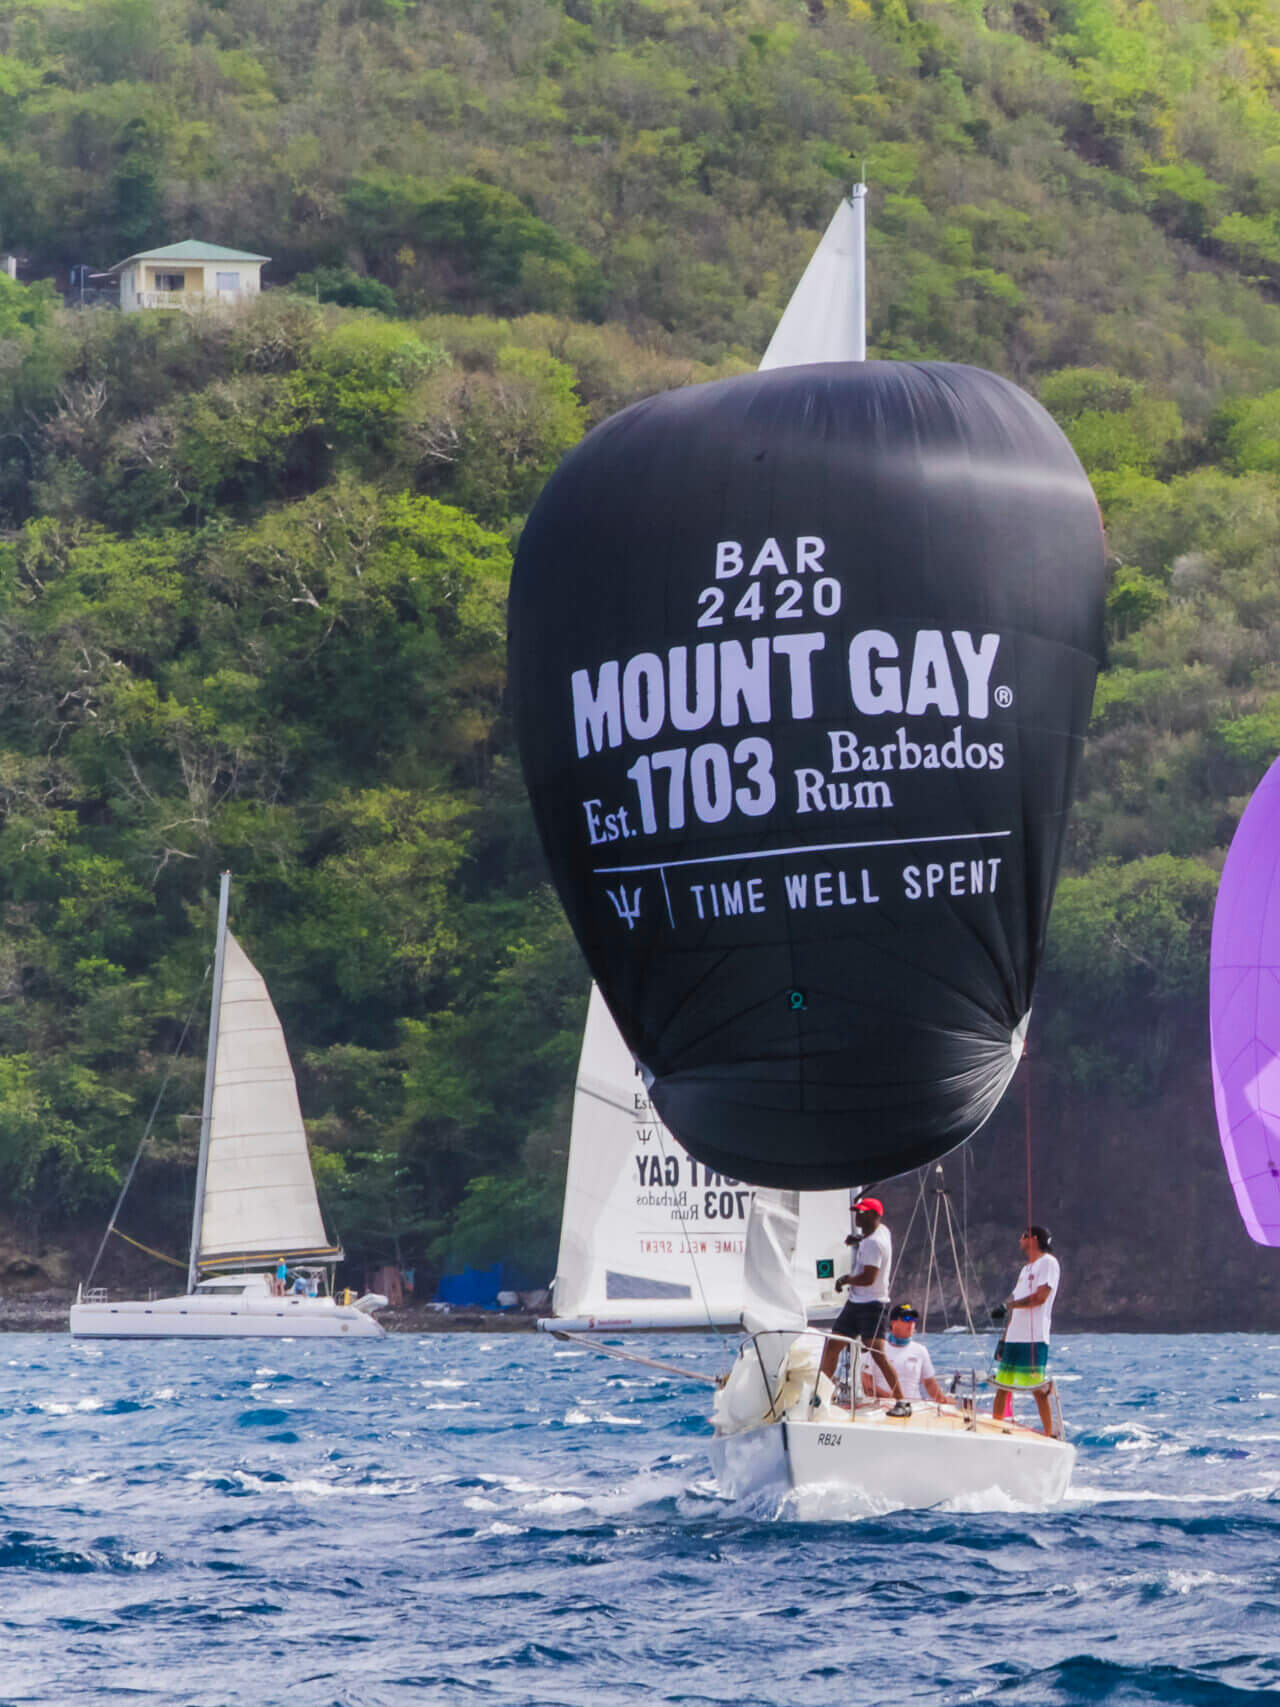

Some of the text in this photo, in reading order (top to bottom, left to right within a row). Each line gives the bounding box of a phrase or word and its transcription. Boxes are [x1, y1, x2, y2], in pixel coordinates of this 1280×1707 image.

[715, 535, 826, 580] BAR
[697, 577, 842, 628] 2420
[571, 631, 826, 758] MOUNT
[827, 725, 1005, 774] Barbados
[583, 736, 776, 844] Est. 1703
[794, 768, 894, 814] Rum
[690, 858, 1002, 919] TIME WELL SPENT
